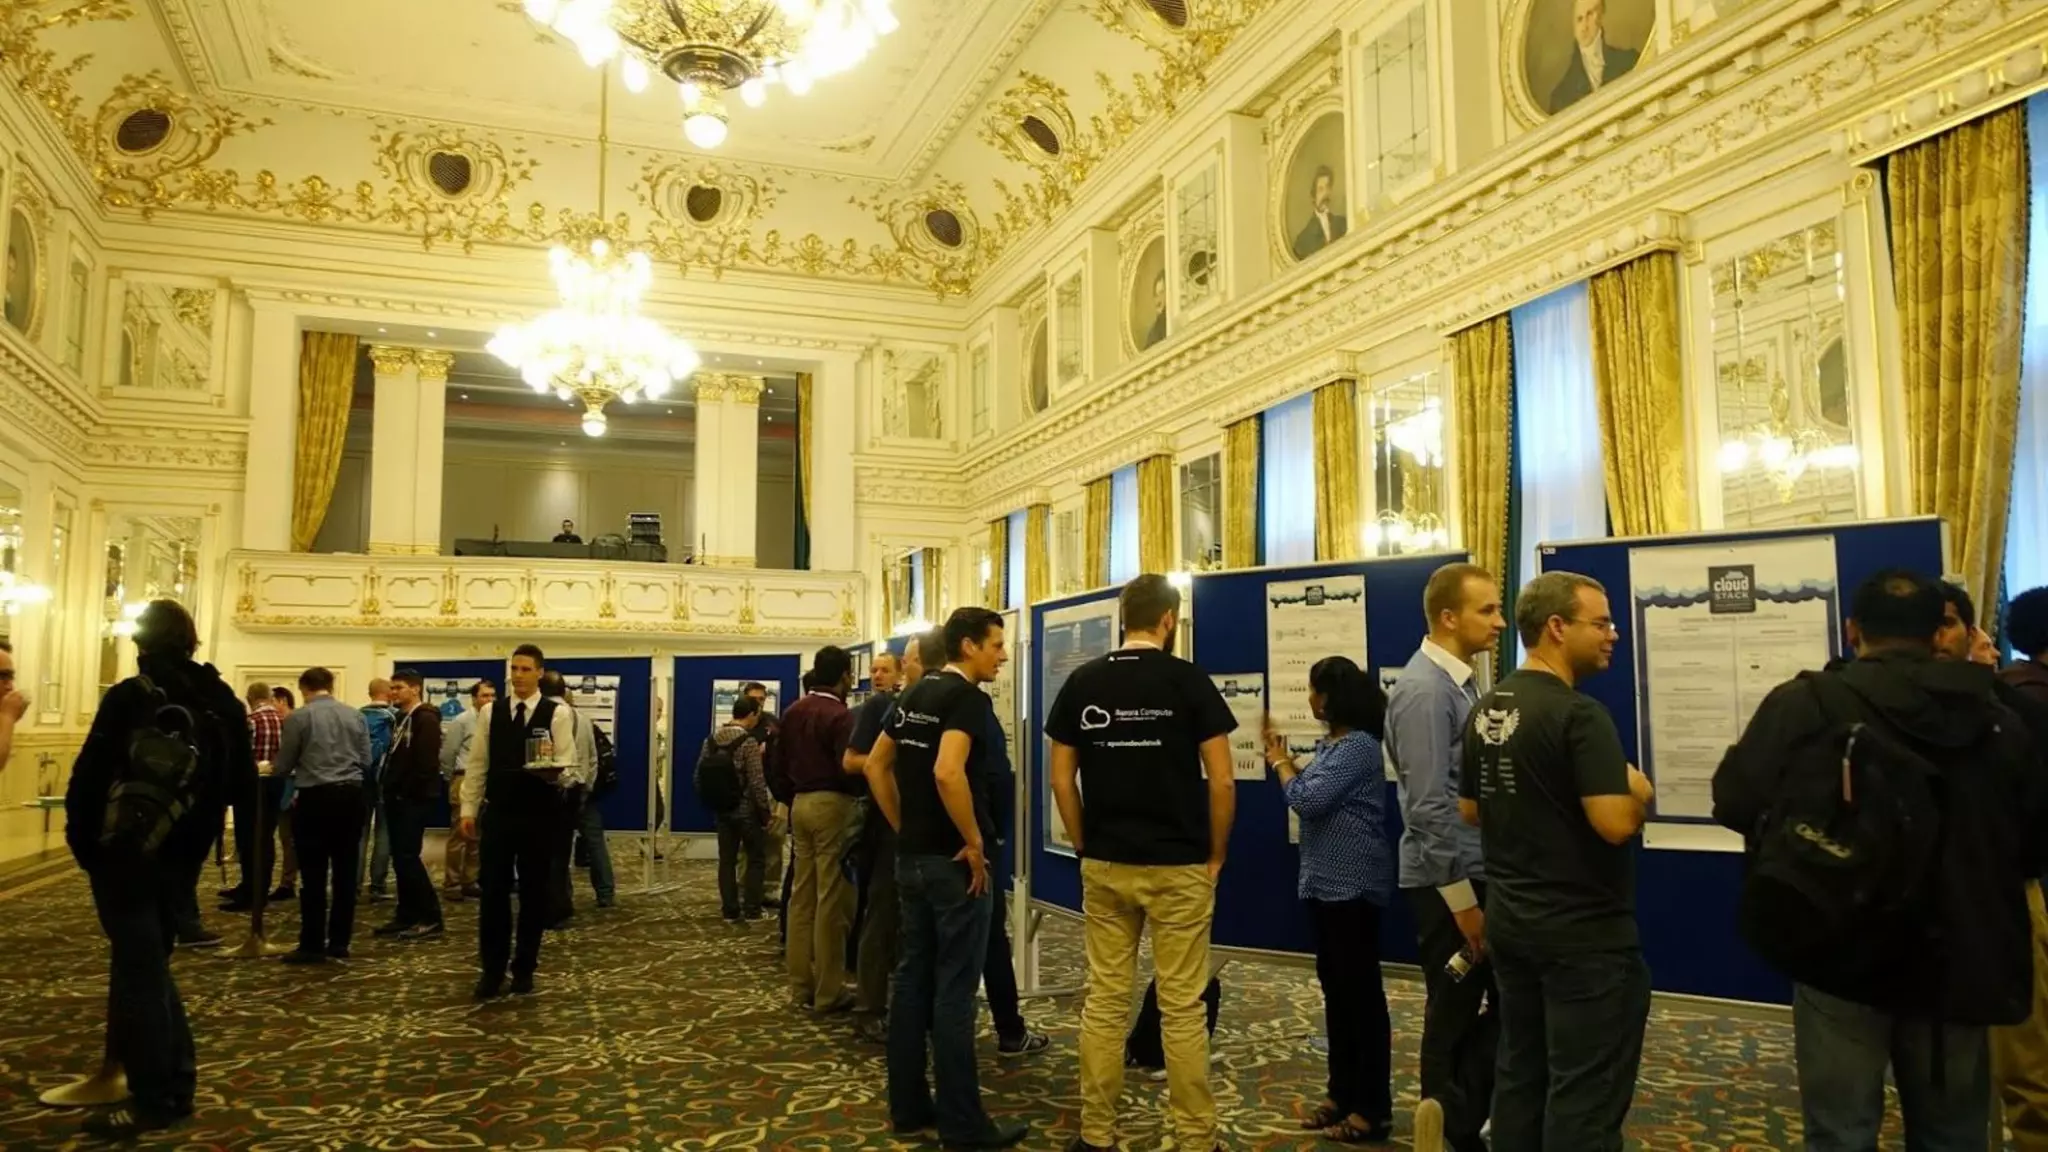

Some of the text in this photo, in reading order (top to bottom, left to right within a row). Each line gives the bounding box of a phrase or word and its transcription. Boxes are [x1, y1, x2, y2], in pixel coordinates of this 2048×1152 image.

[1713, 575, 1749, 592] cloud
[1714, 591, 1749, 600] STACK
[1140, 708, 1174, 717] Compute
